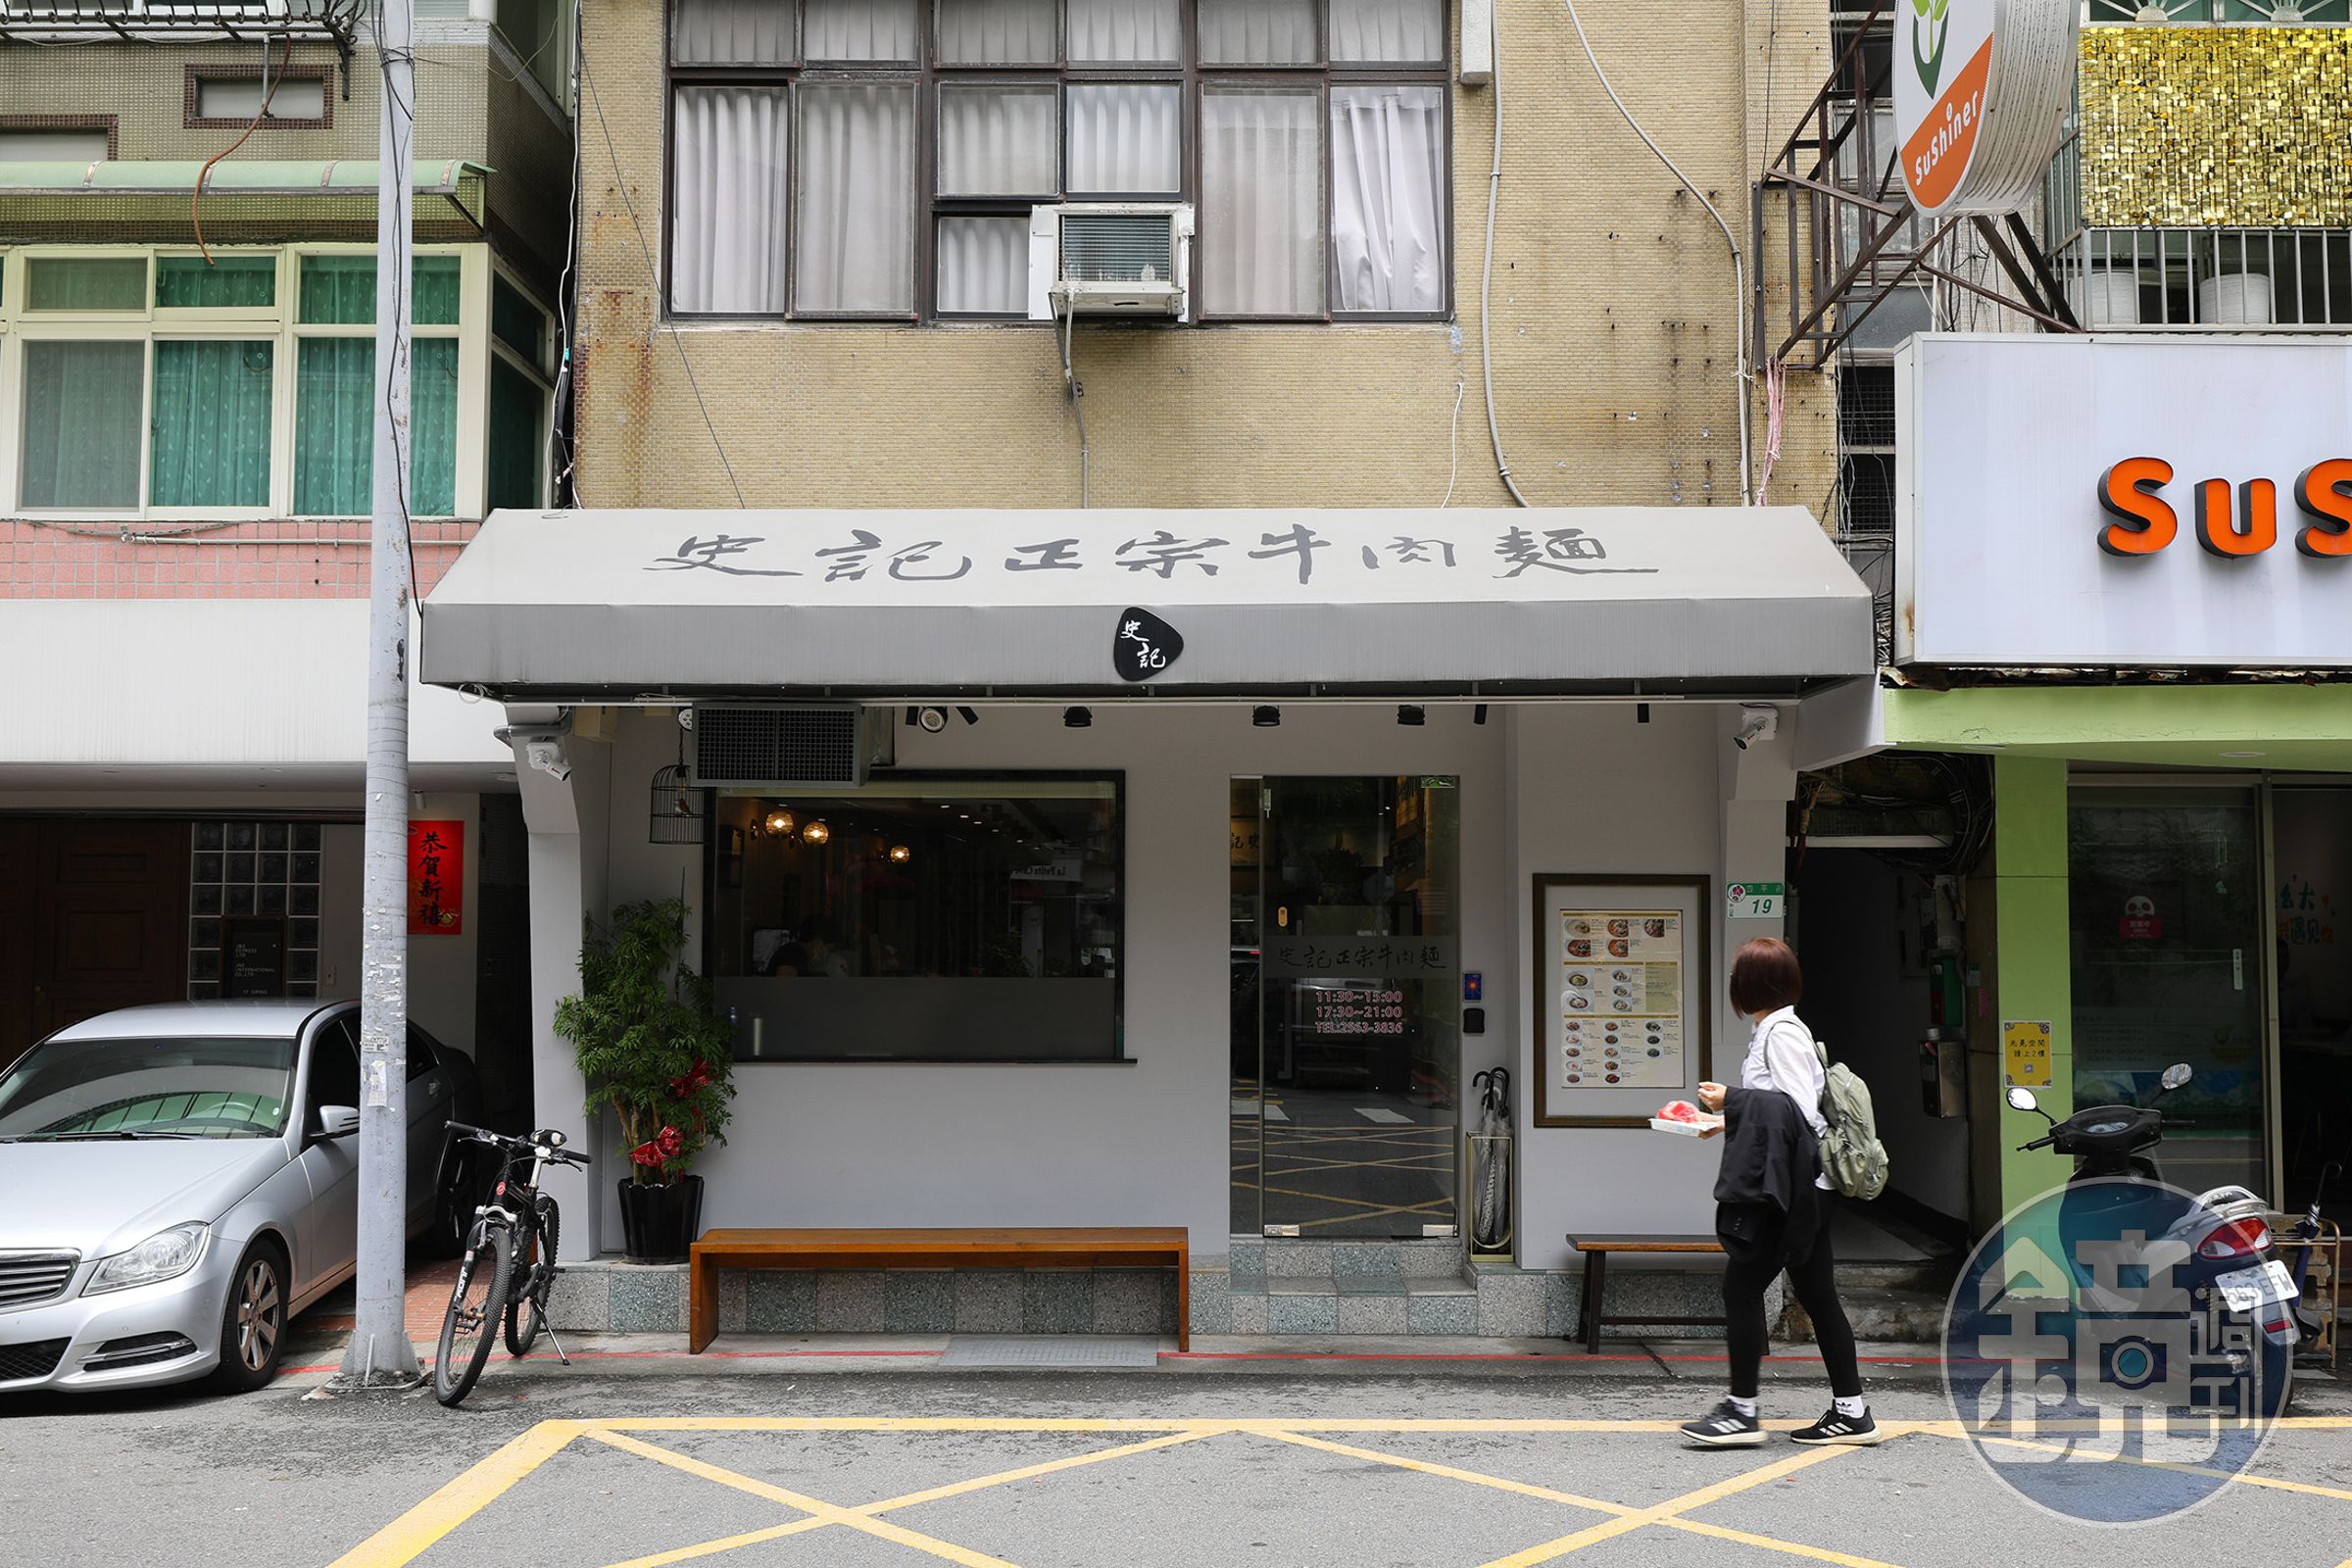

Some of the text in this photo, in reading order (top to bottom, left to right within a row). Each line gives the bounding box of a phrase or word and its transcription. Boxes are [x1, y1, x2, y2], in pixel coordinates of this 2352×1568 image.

[1120, 619, 1166, 668] 史記
[416, 831, 448, 925] 恭賀新禧
[1752, 899, 1773, 914] 19
[1278, 944, 1447, 970] 史記正宗牛肉麵
